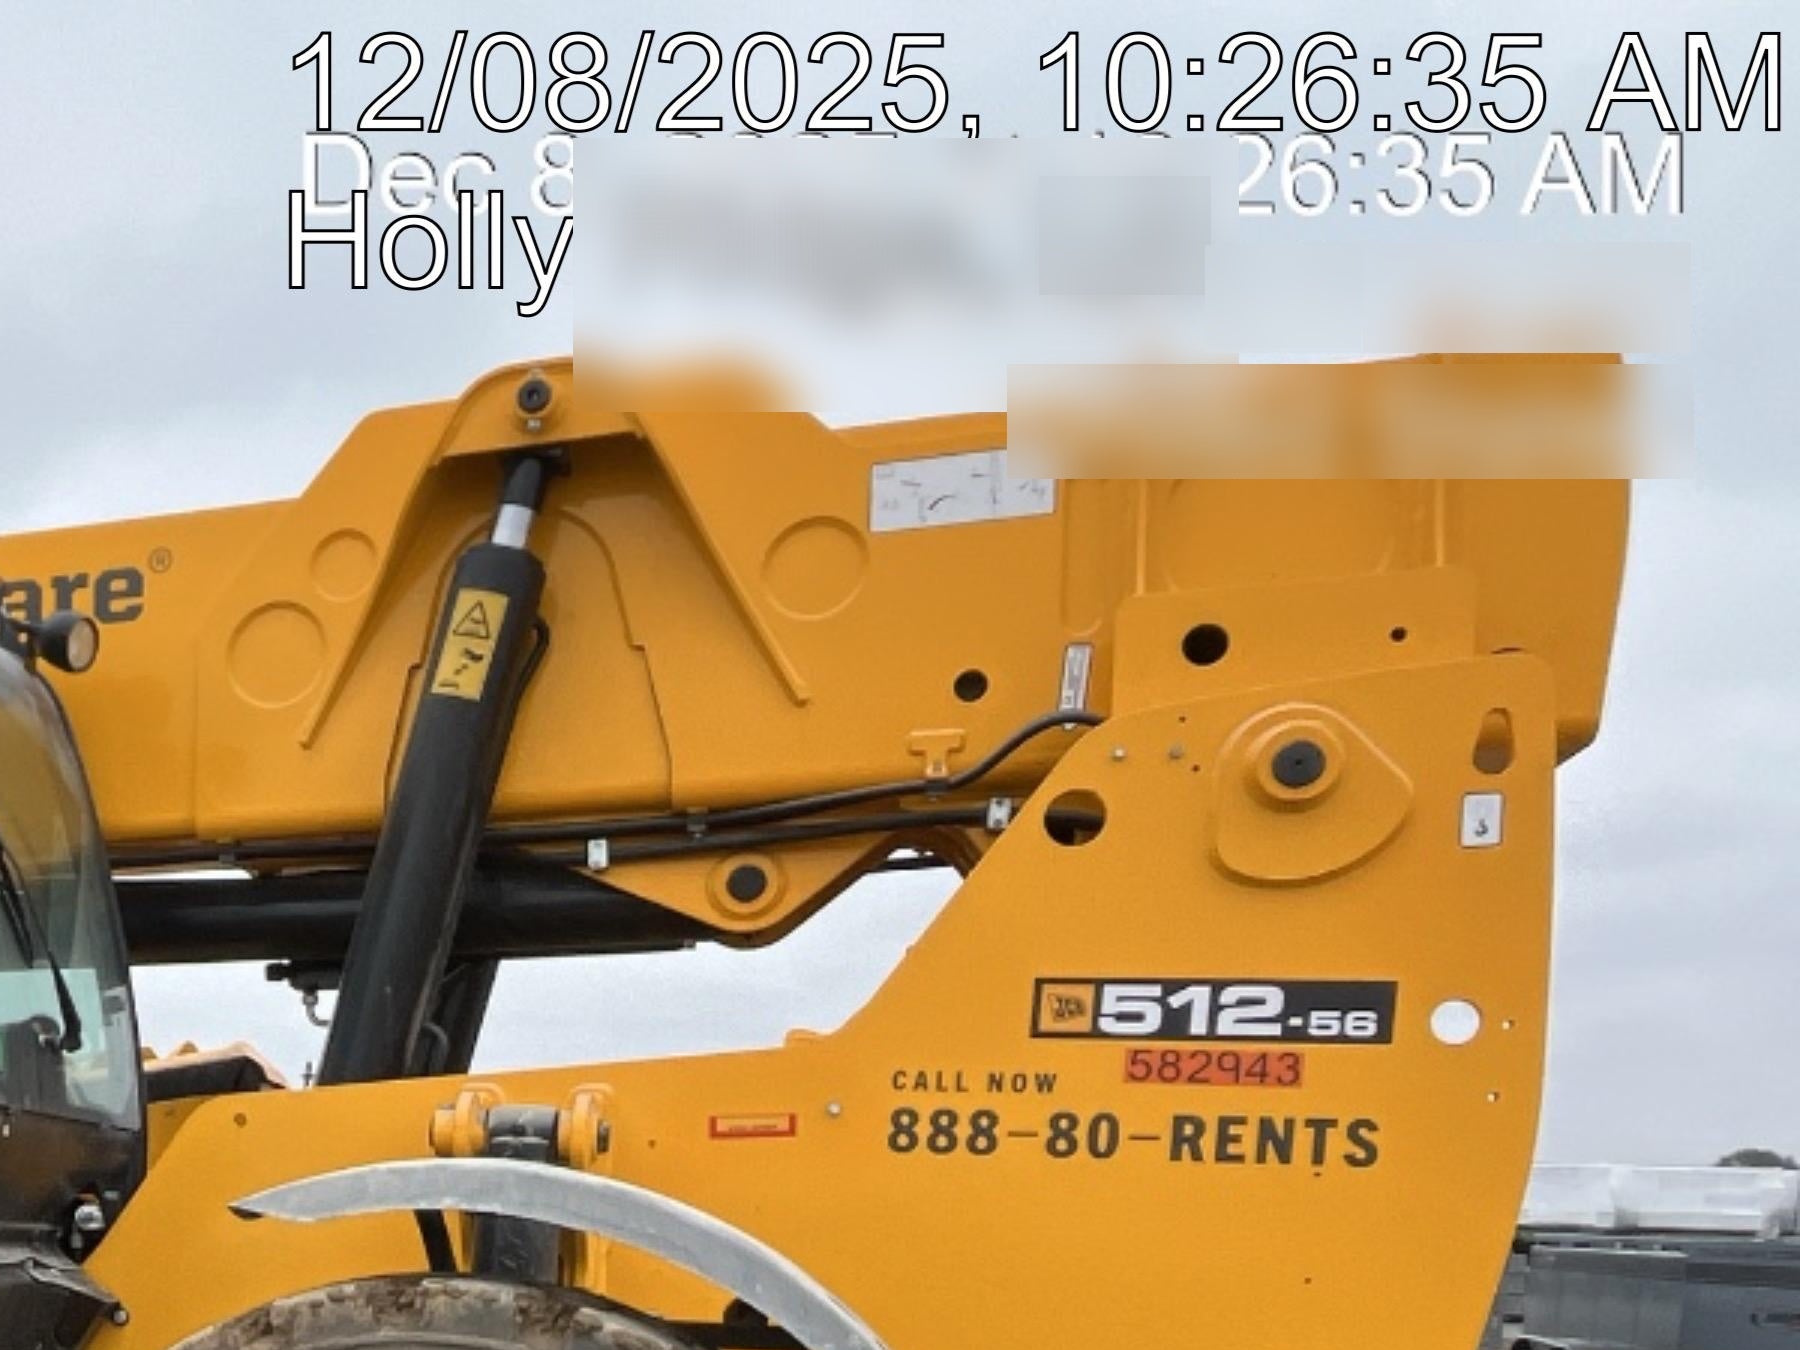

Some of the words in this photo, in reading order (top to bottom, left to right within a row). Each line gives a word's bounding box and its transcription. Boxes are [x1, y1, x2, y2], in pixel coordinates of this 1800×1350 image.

[892, 1069, 970, 1094] CALL
[986, 1071, 1058, 1095] NOW
[1128, 1048, 1301, 1086] 582943
[887, 1107, 1381, 1169] 888-80-RENTS
